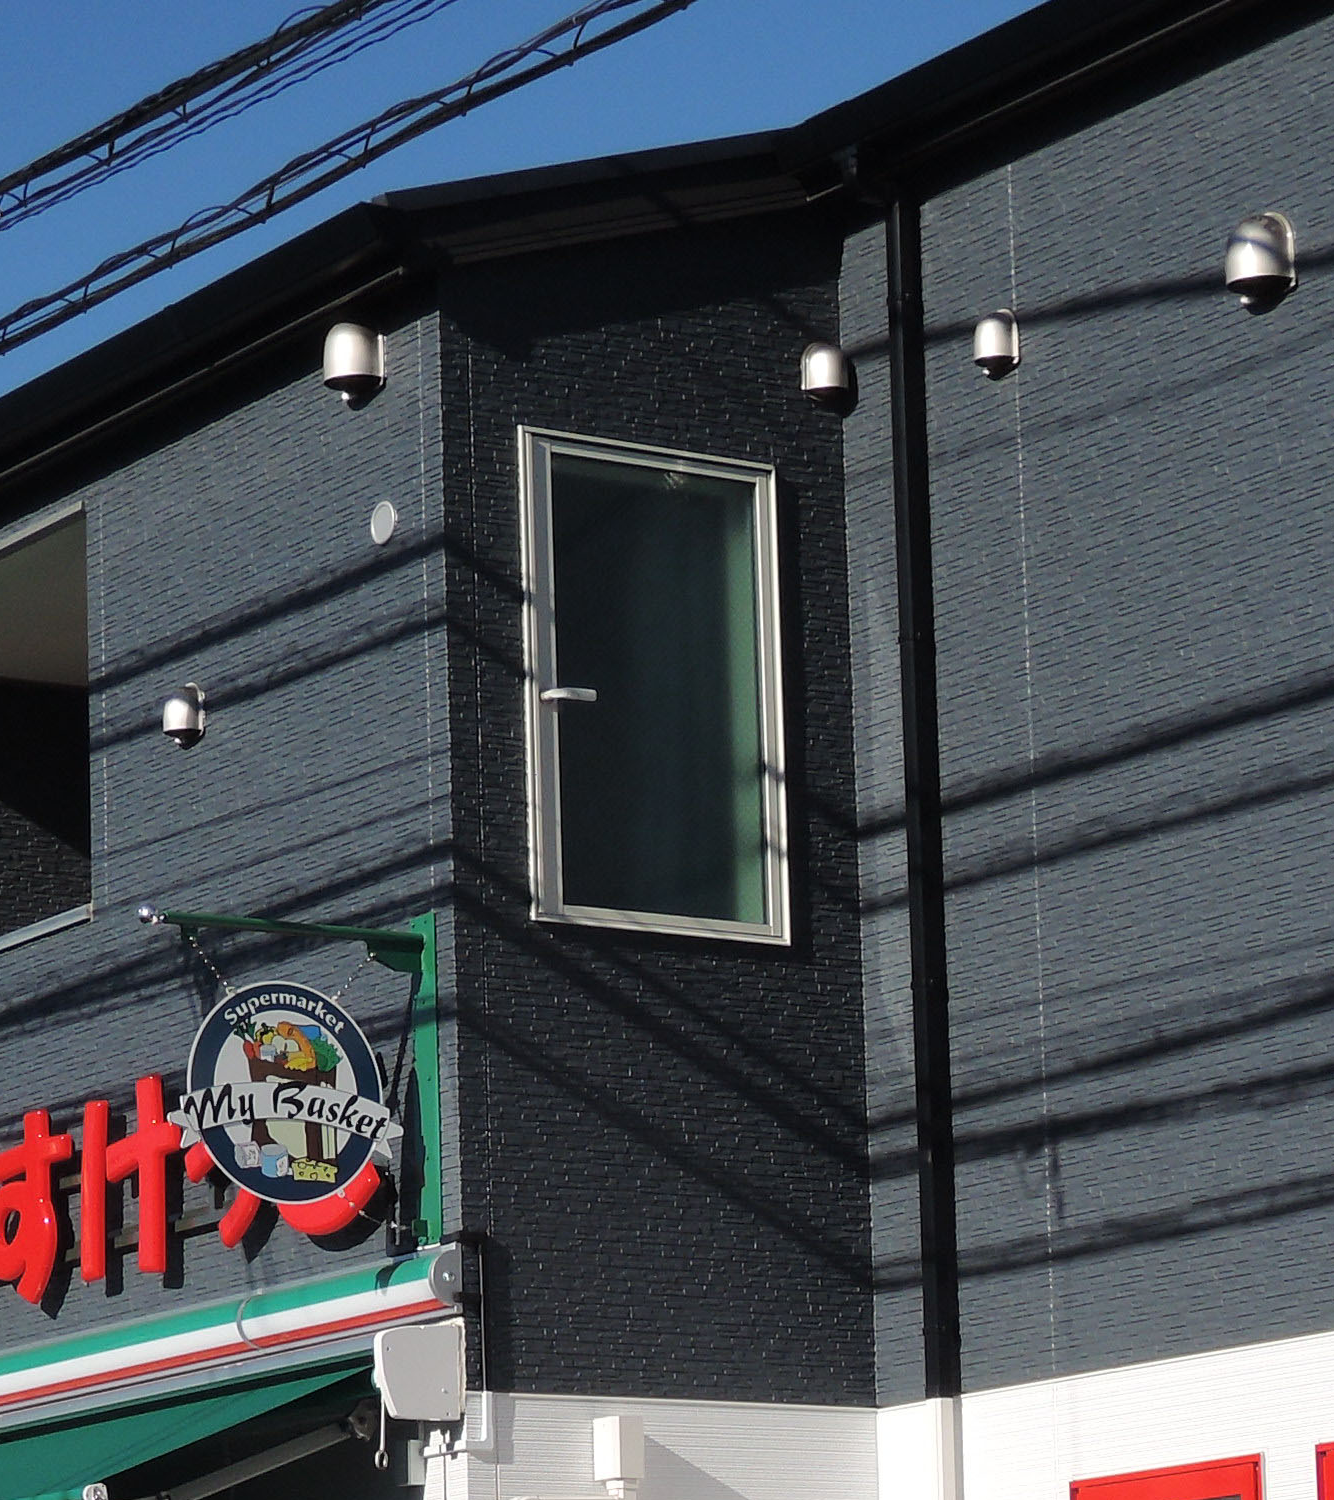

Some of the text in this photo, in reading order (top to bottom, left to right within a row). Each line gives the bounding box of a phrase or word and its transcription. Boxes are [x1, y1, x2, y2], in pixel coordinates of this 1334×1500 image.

[224, 992, 345, 1034] Supermarket
[183, 1081, 388, 1140] My Basket
